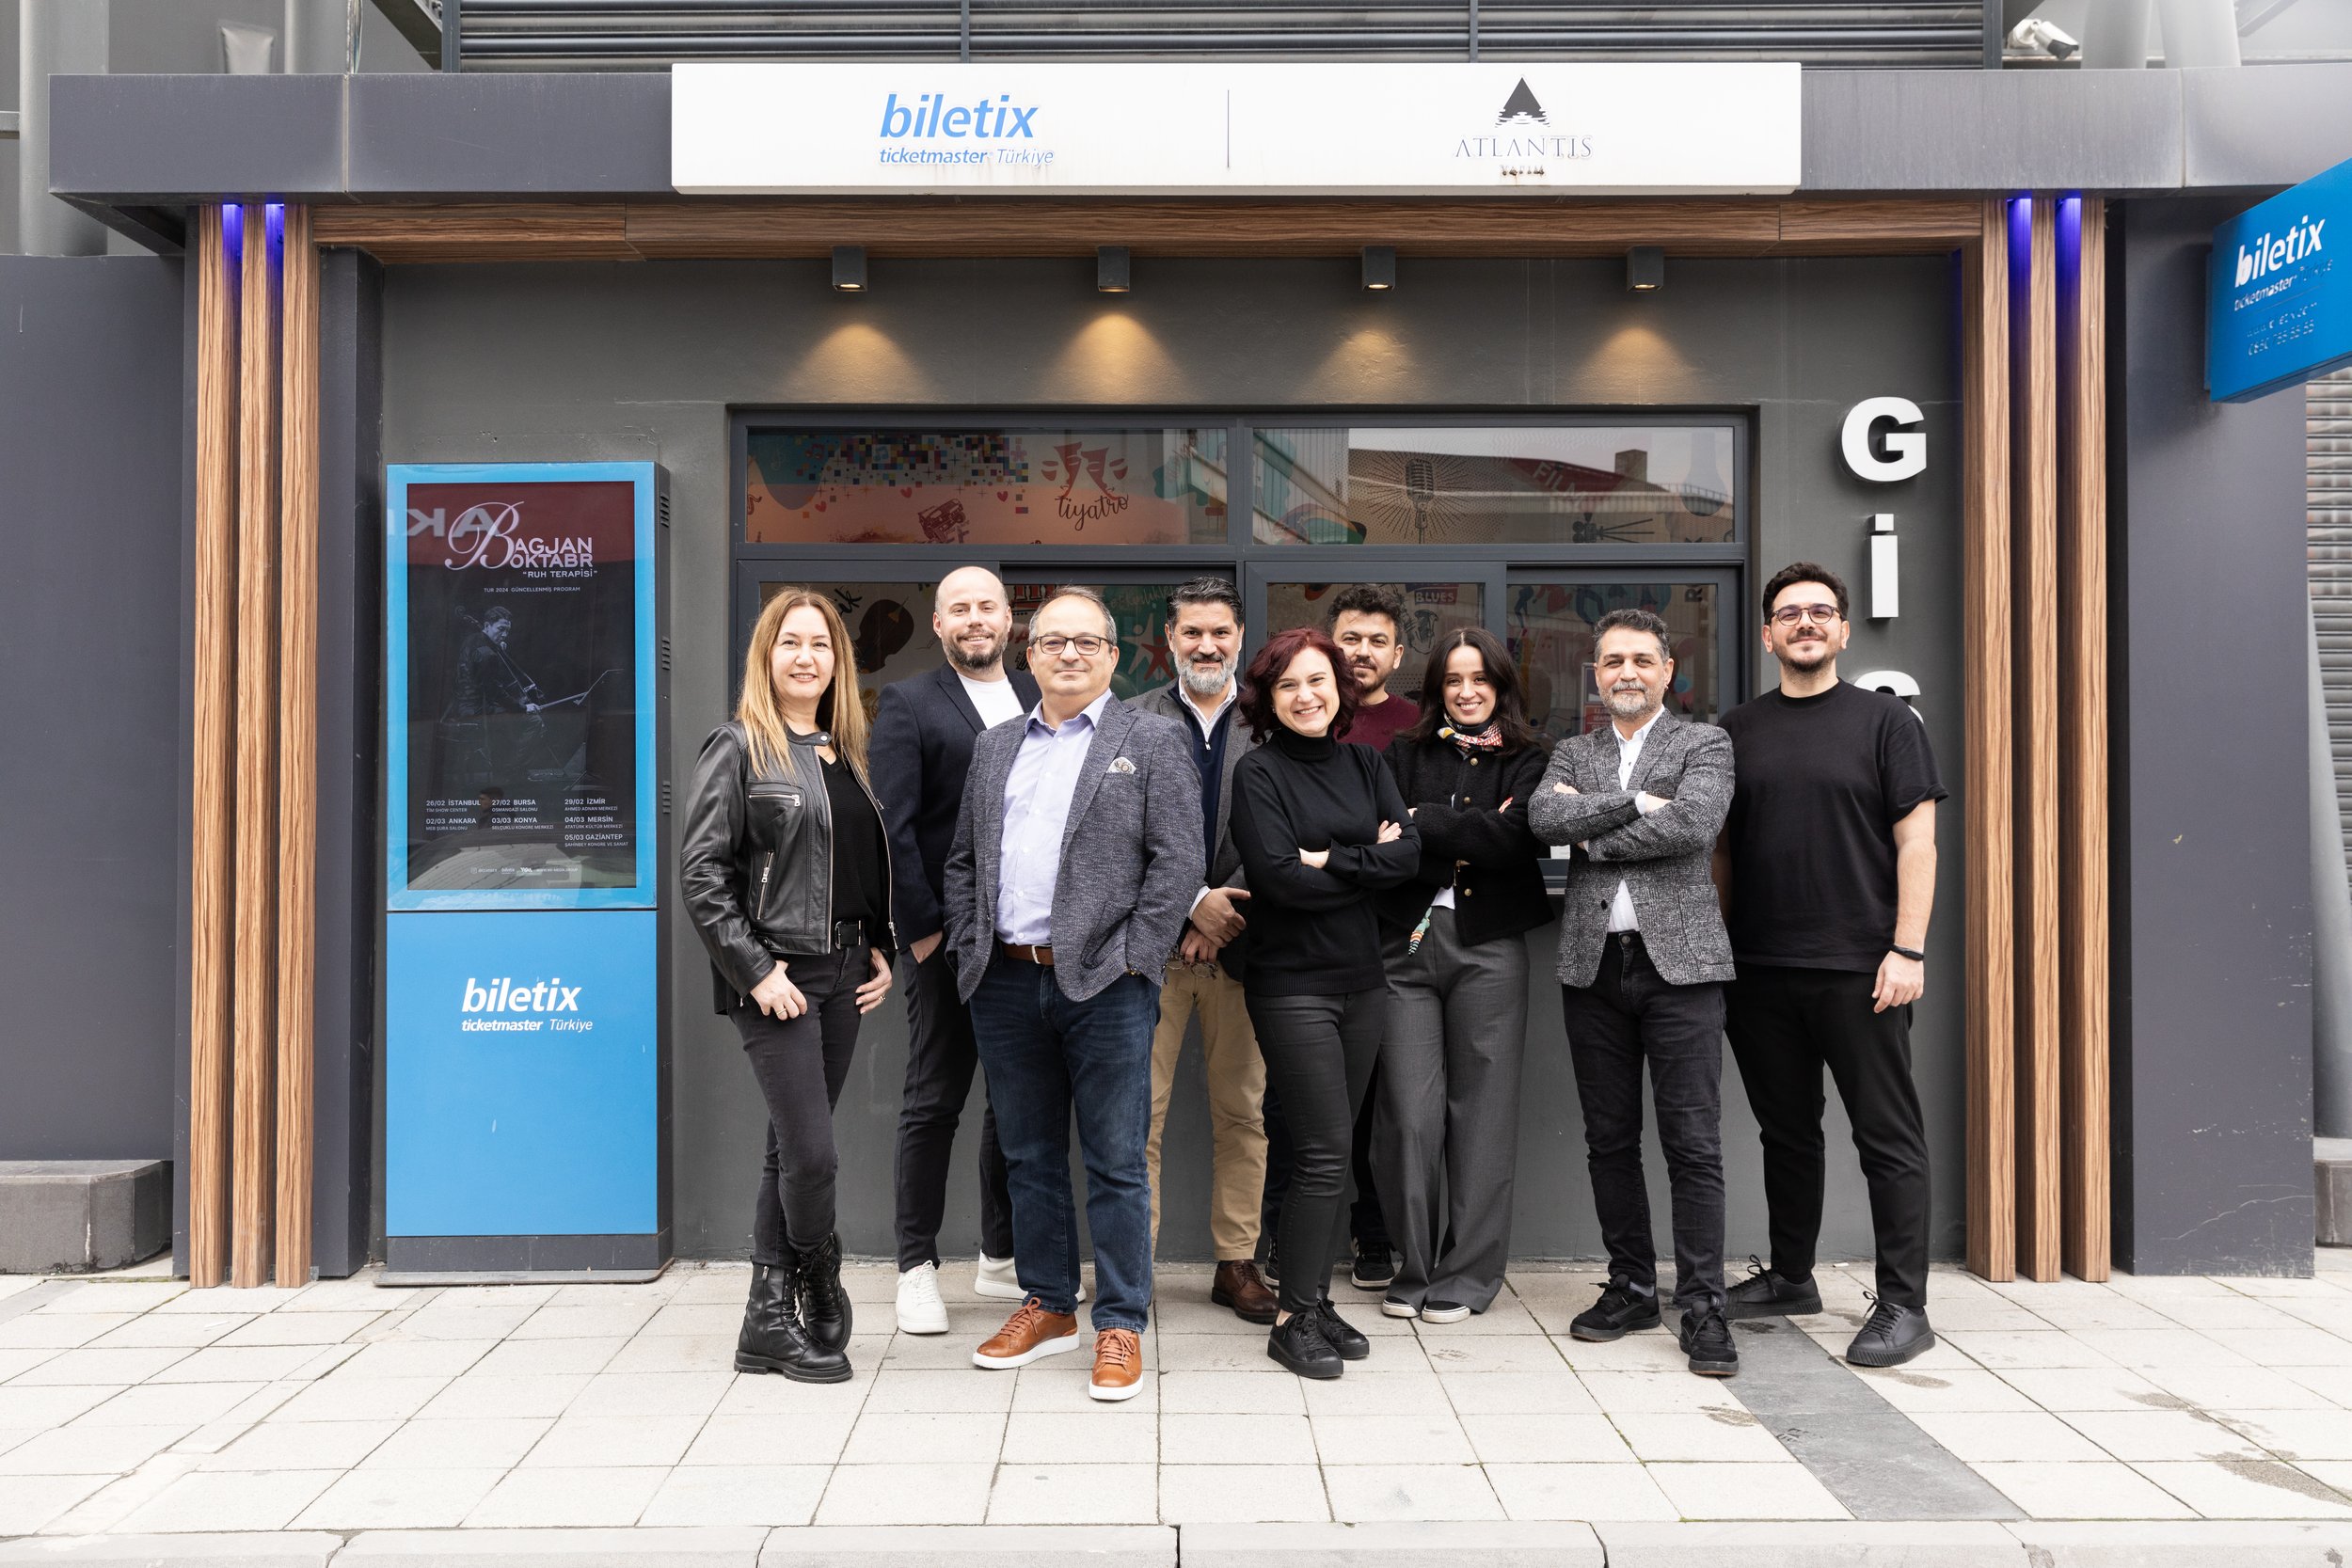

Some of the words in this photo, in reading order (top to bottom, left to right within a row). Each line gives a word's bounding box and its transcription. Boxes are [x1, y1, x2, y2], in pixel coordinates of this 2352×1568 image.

[880, 93, 1039, 137] biletix
[880, 147, 988, 164] ticketmaster
[997, 148, 1054, 166] Türkiye
[1455, 137, 1592, 157] ATLANTIS
[2234, 214, 2326, 288] biletix
[1055, 494, 1129, 531] tiyatro
[1415, 591, 1454, 602] BLUES
[448, 798, 481, 806] İSTANBUL
[461, 977, 582, 1013] biletix
[461, 1018, 544, 1032] ticketmaster
[549, 1018, 594, 1033] Türkiye
